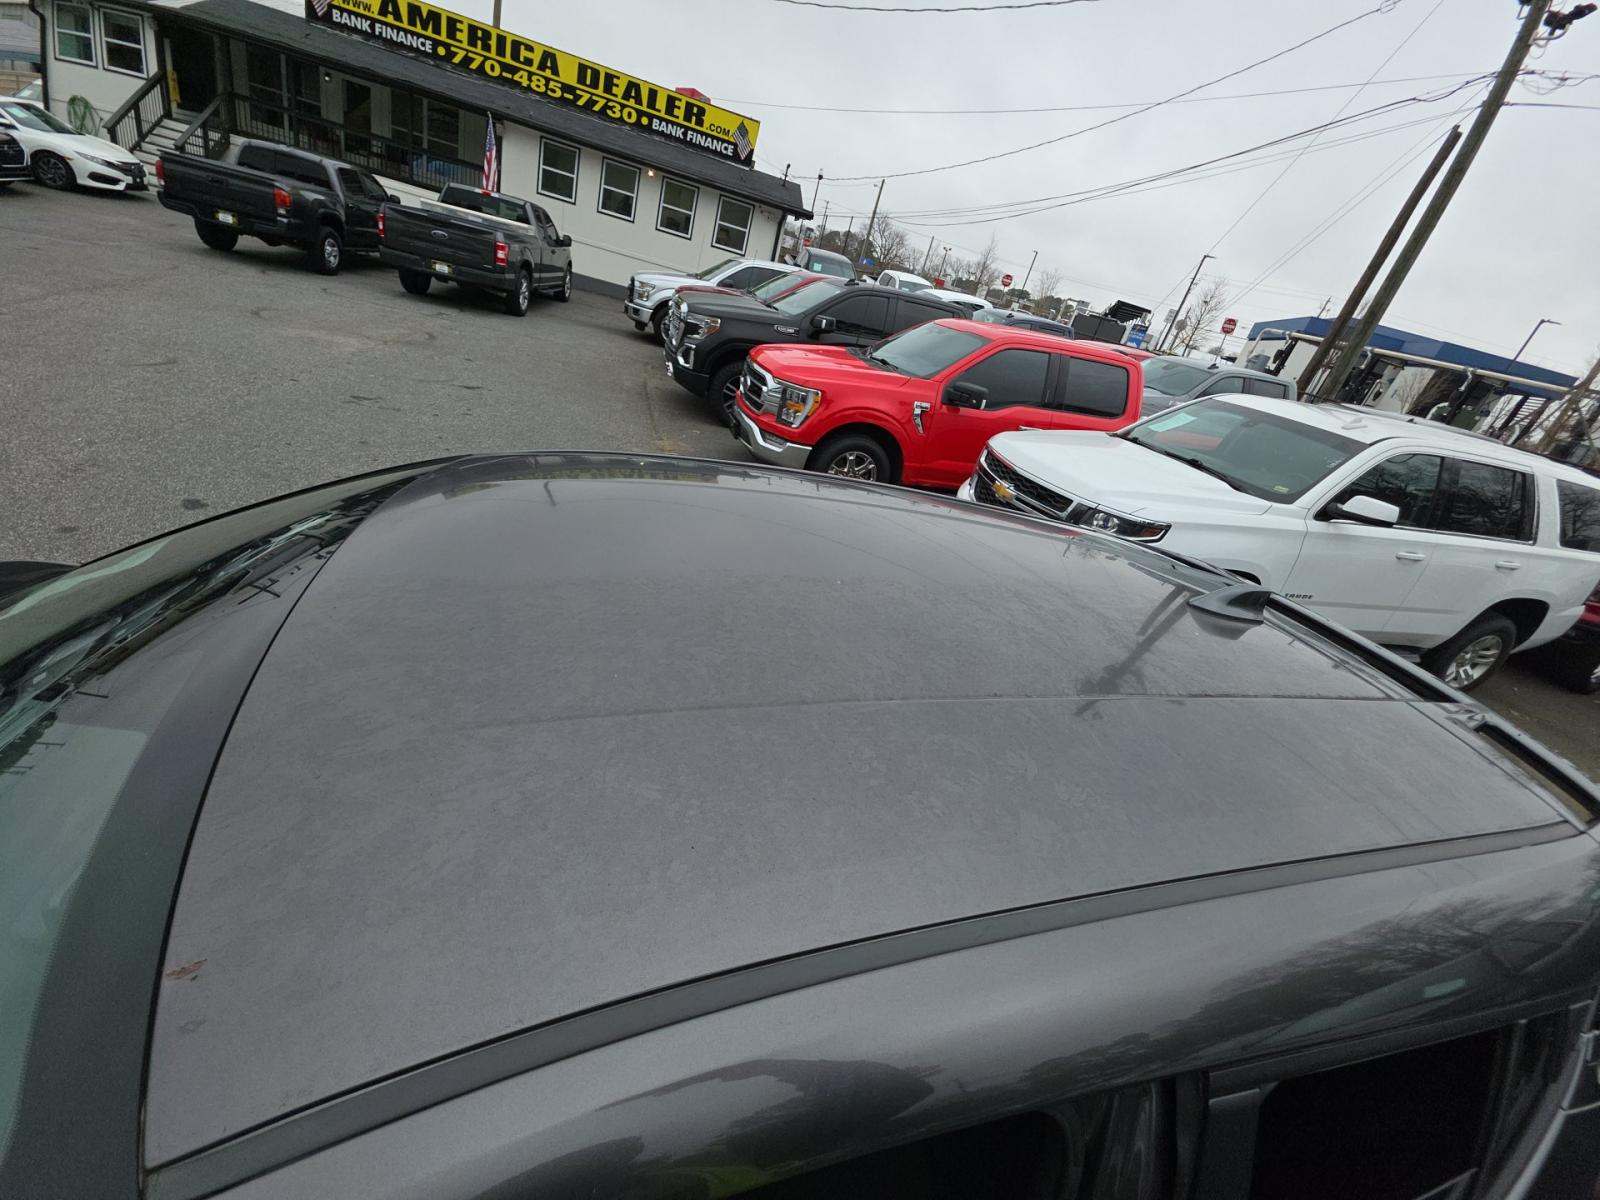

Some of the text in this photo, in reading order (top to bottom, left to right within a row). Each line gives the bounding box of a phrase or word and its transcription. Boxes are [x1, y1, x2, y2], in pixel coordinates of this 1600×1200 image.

[332, 9, 734, 156] BANK FINANCE 770-485-7730 BANK FINANCE
[378, 0, 560, 77] AMERICA
[576, 61, 706, 127] DEALER
